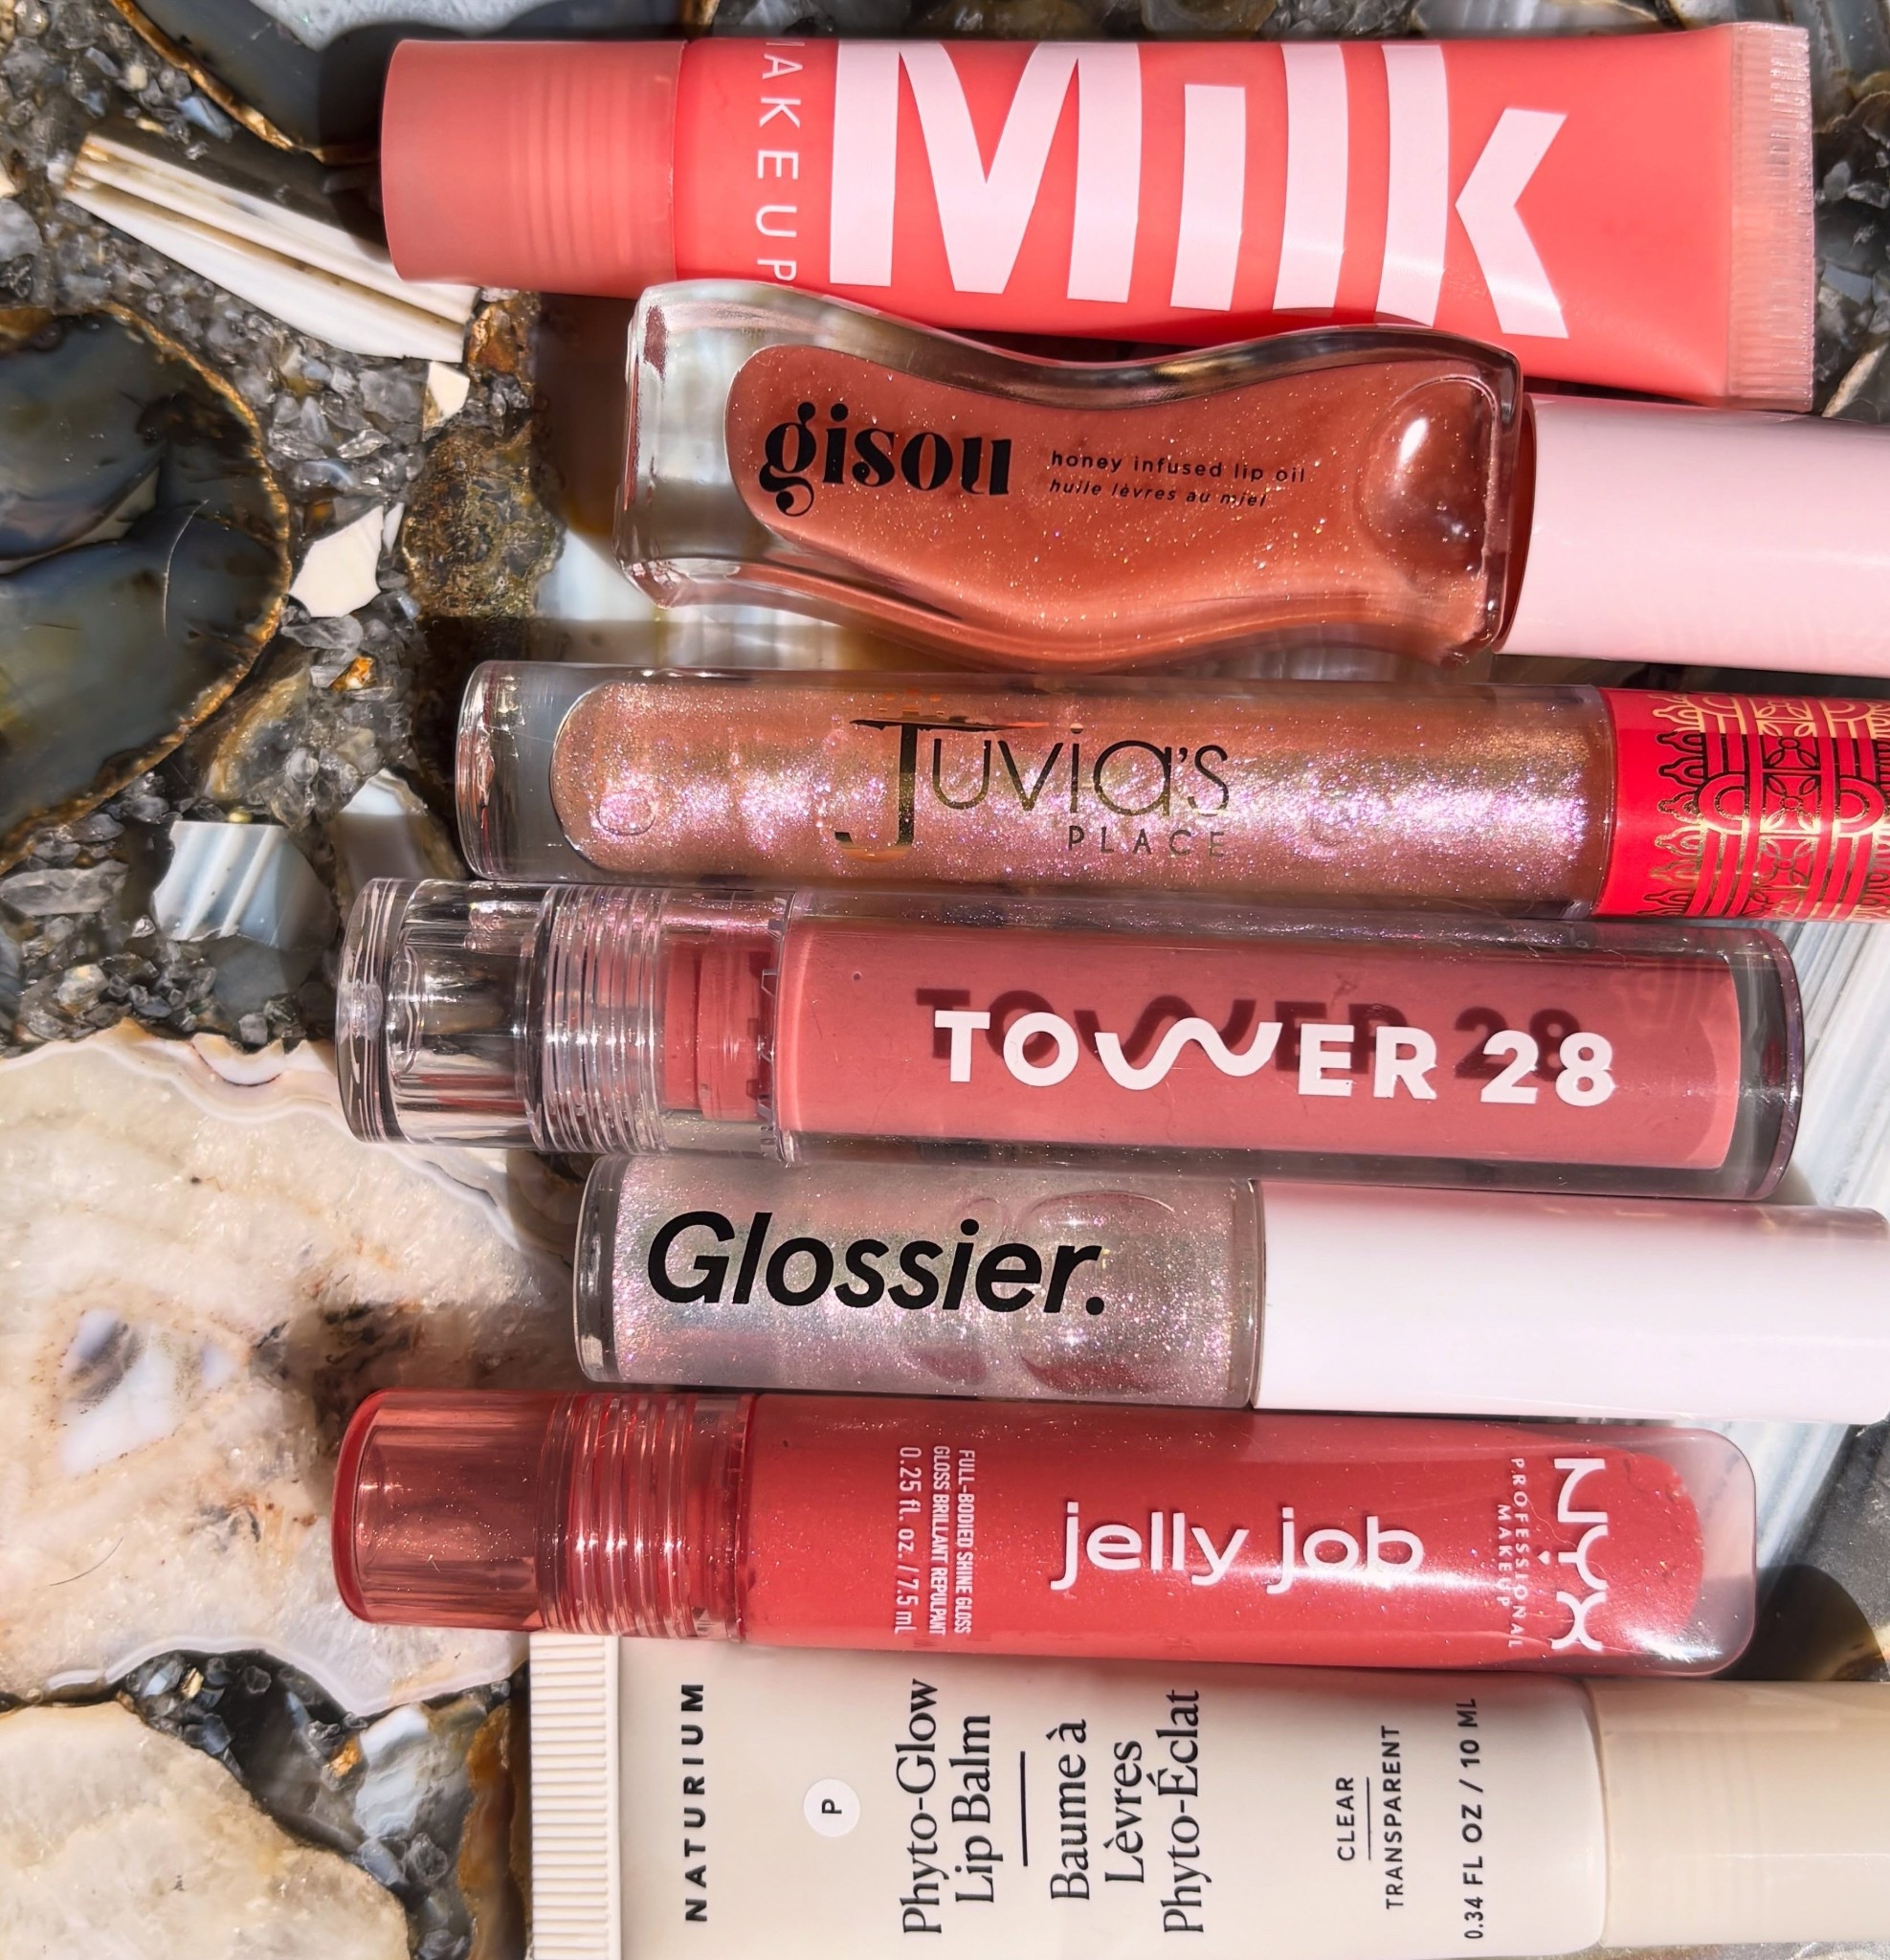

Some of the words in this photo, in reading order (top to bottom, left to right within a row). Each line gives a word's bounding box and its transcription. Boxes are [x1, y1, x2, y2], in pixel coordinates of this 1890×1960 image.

[756, 42, 805, 281] AKEUP
[759, 402, 1011, 517] gisou
[1050, 479, 1101, 497] huile
[1112, 484, 1176, 501] lèvres
[1187, 491, 1211, 503] au
[1220, 492, 1266, 507] miel
[1052, 450, 1122, 473] honey
[1134, 455, 1222, 478] infused
[1234, 463, 1263, 482] lip
[1276, 468, 1304, 483] oil
[1068, 825, 1225, 858] PLACE
[934, 1010, 1436, 1101] TOWER
[1480, 1030, 1614, 1107] 28
[647, 1210, 1105, 1316] Glossier.
[899, 1446, 923, 1492] 0.25
[933, 1445, 951, 1490] GLOSS
[957, 1449, 976, 1548] FULL-BODIED
[897, 1528, 916, 1559] oz.
[898, 1499, 922, 1522] fl.
[930, 1494, 950, 1564] BRILLANT
[955, 1551, 974, 1593] SHINE
[1050, 1501, 1249, 1591] jelly
[1267, 1506, 1424, 1593] job
[1496, 1504, 1513, 1607] MAKEUP
[1507, 1458, 1530, 1648] PROFESSIONAL
[1551, 1458, 1609, 1651] NYX
[928, 1567, 948, 1636] REPULPANT
[953, 1596, 973, 1634] GLOSS
[1046, 1718, 1087, 1745] à
[1456, 1698, 1478, 1727] ML
[948, 1715, 992, 1824] Balm
[1458, 1778, 1483, 1793] /
[1459, 1739, 1480, 1768] 10
[680, 1684, 708, 1923] NATURIUM
[821, 1798, 842, 1815] P
[896, 1678, 949, 1935] Phyto-Glow
[1050, 1753, 1090, 1901] Baume
[1104, 1740, 1145, 1884] Lèvres
[1147, 1689, 1212, 1934] Phyto-Éclat
[1336, 1776, 1355, 1861] CLEAR
[1381, 1726, 1404, 1910] TRANSPARENT
[1460, 1804, 1483, 1843] OZ
[955, 1835, 1004, 1904] Lip
[1462, 1856, 1483, 1885] FL
[1463, 1896, 1484, 1940] 0.34
